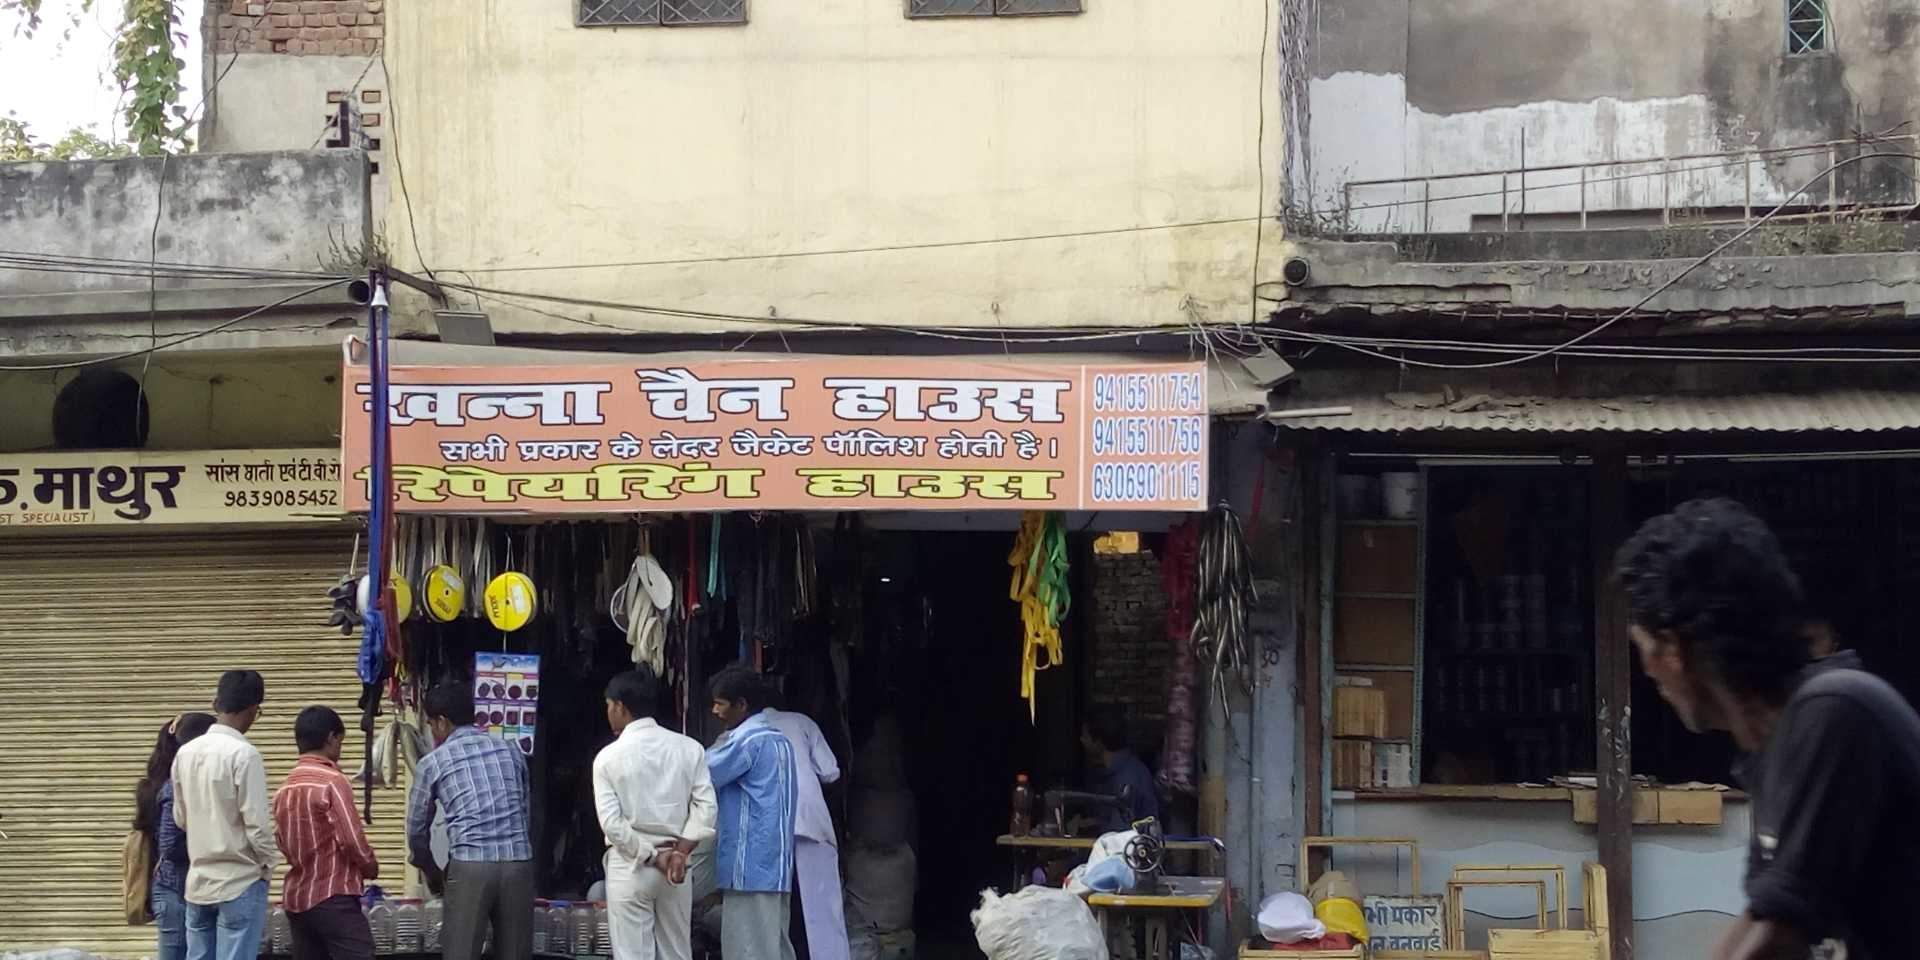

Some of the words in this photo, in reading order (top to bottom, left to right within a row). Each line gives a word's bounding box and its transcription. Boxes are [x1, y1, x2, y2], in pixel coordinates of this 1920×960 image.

[355, 383, 612, 426] खन्ना
[635, 367, 795, 423] चैन
[824, 378, 1071, 423] हाउस
[1094, 374, 1200, 411] 9415511754
[440, 432, 508, 461] सभी
[517, 440, 600, 462] प्रकार
[609, 432, 642, 460] के
[651, 431, 721, 459] लेदर
[731, 428, 813, 457] जैकेट
[823, 428, 928, 458] पॉलिश
[937, 430, 1006, 458] होती
[1093, 416, 1200, 455] 9415511756
[204, 458, 241, 482] सांस
[354, 462, 765, 502] रिपेयरिंग
[796, 468, 1064, 500] हाउस
[1092, 461, 1200, 502] 6306901115
[224, 490, 338, 507] 9839085452
[1365, 901, 1388, 926] भी
